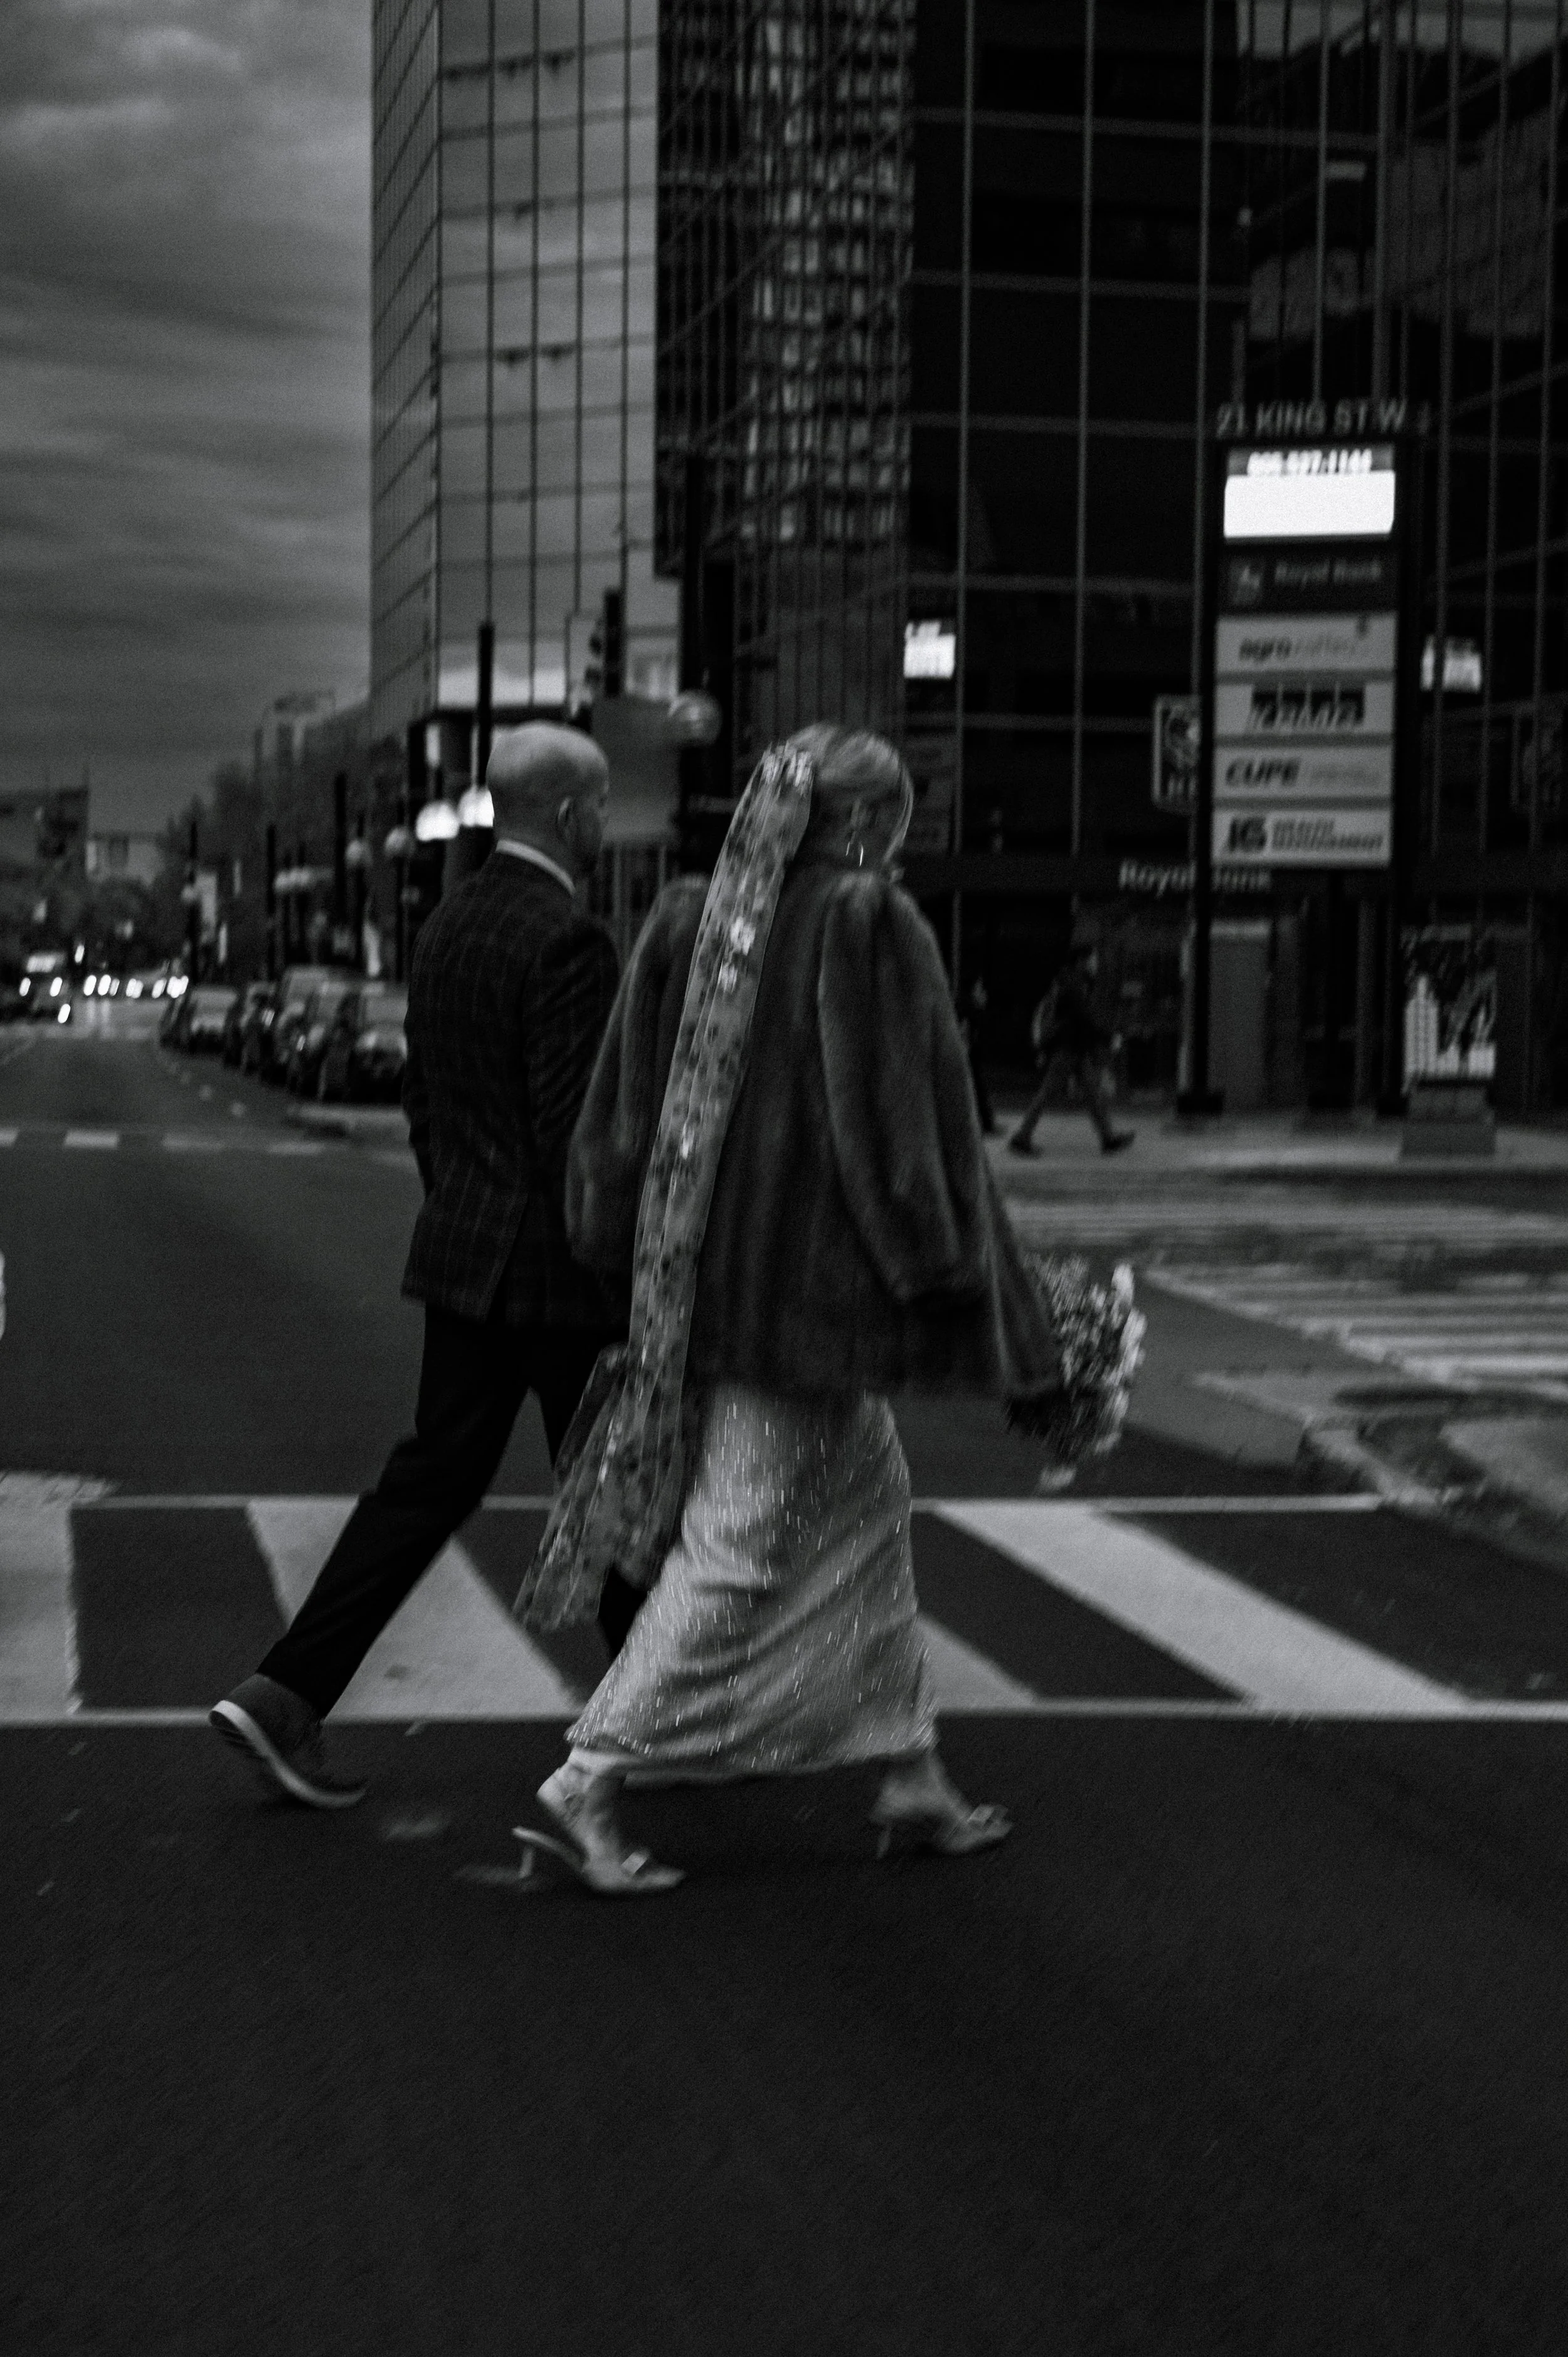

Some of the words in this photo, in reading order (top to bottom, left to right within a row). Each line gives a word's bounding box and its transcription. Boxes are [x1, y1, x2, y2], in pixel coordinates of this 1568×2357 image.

[1216, 403, 1248, 438] 21
[1255, 400, 1327, 436] KING
[1333, 398, 1369, 434] ST
[1379, 397, 1407, 433] W
[1119, 858, 1195, 899] Royal
